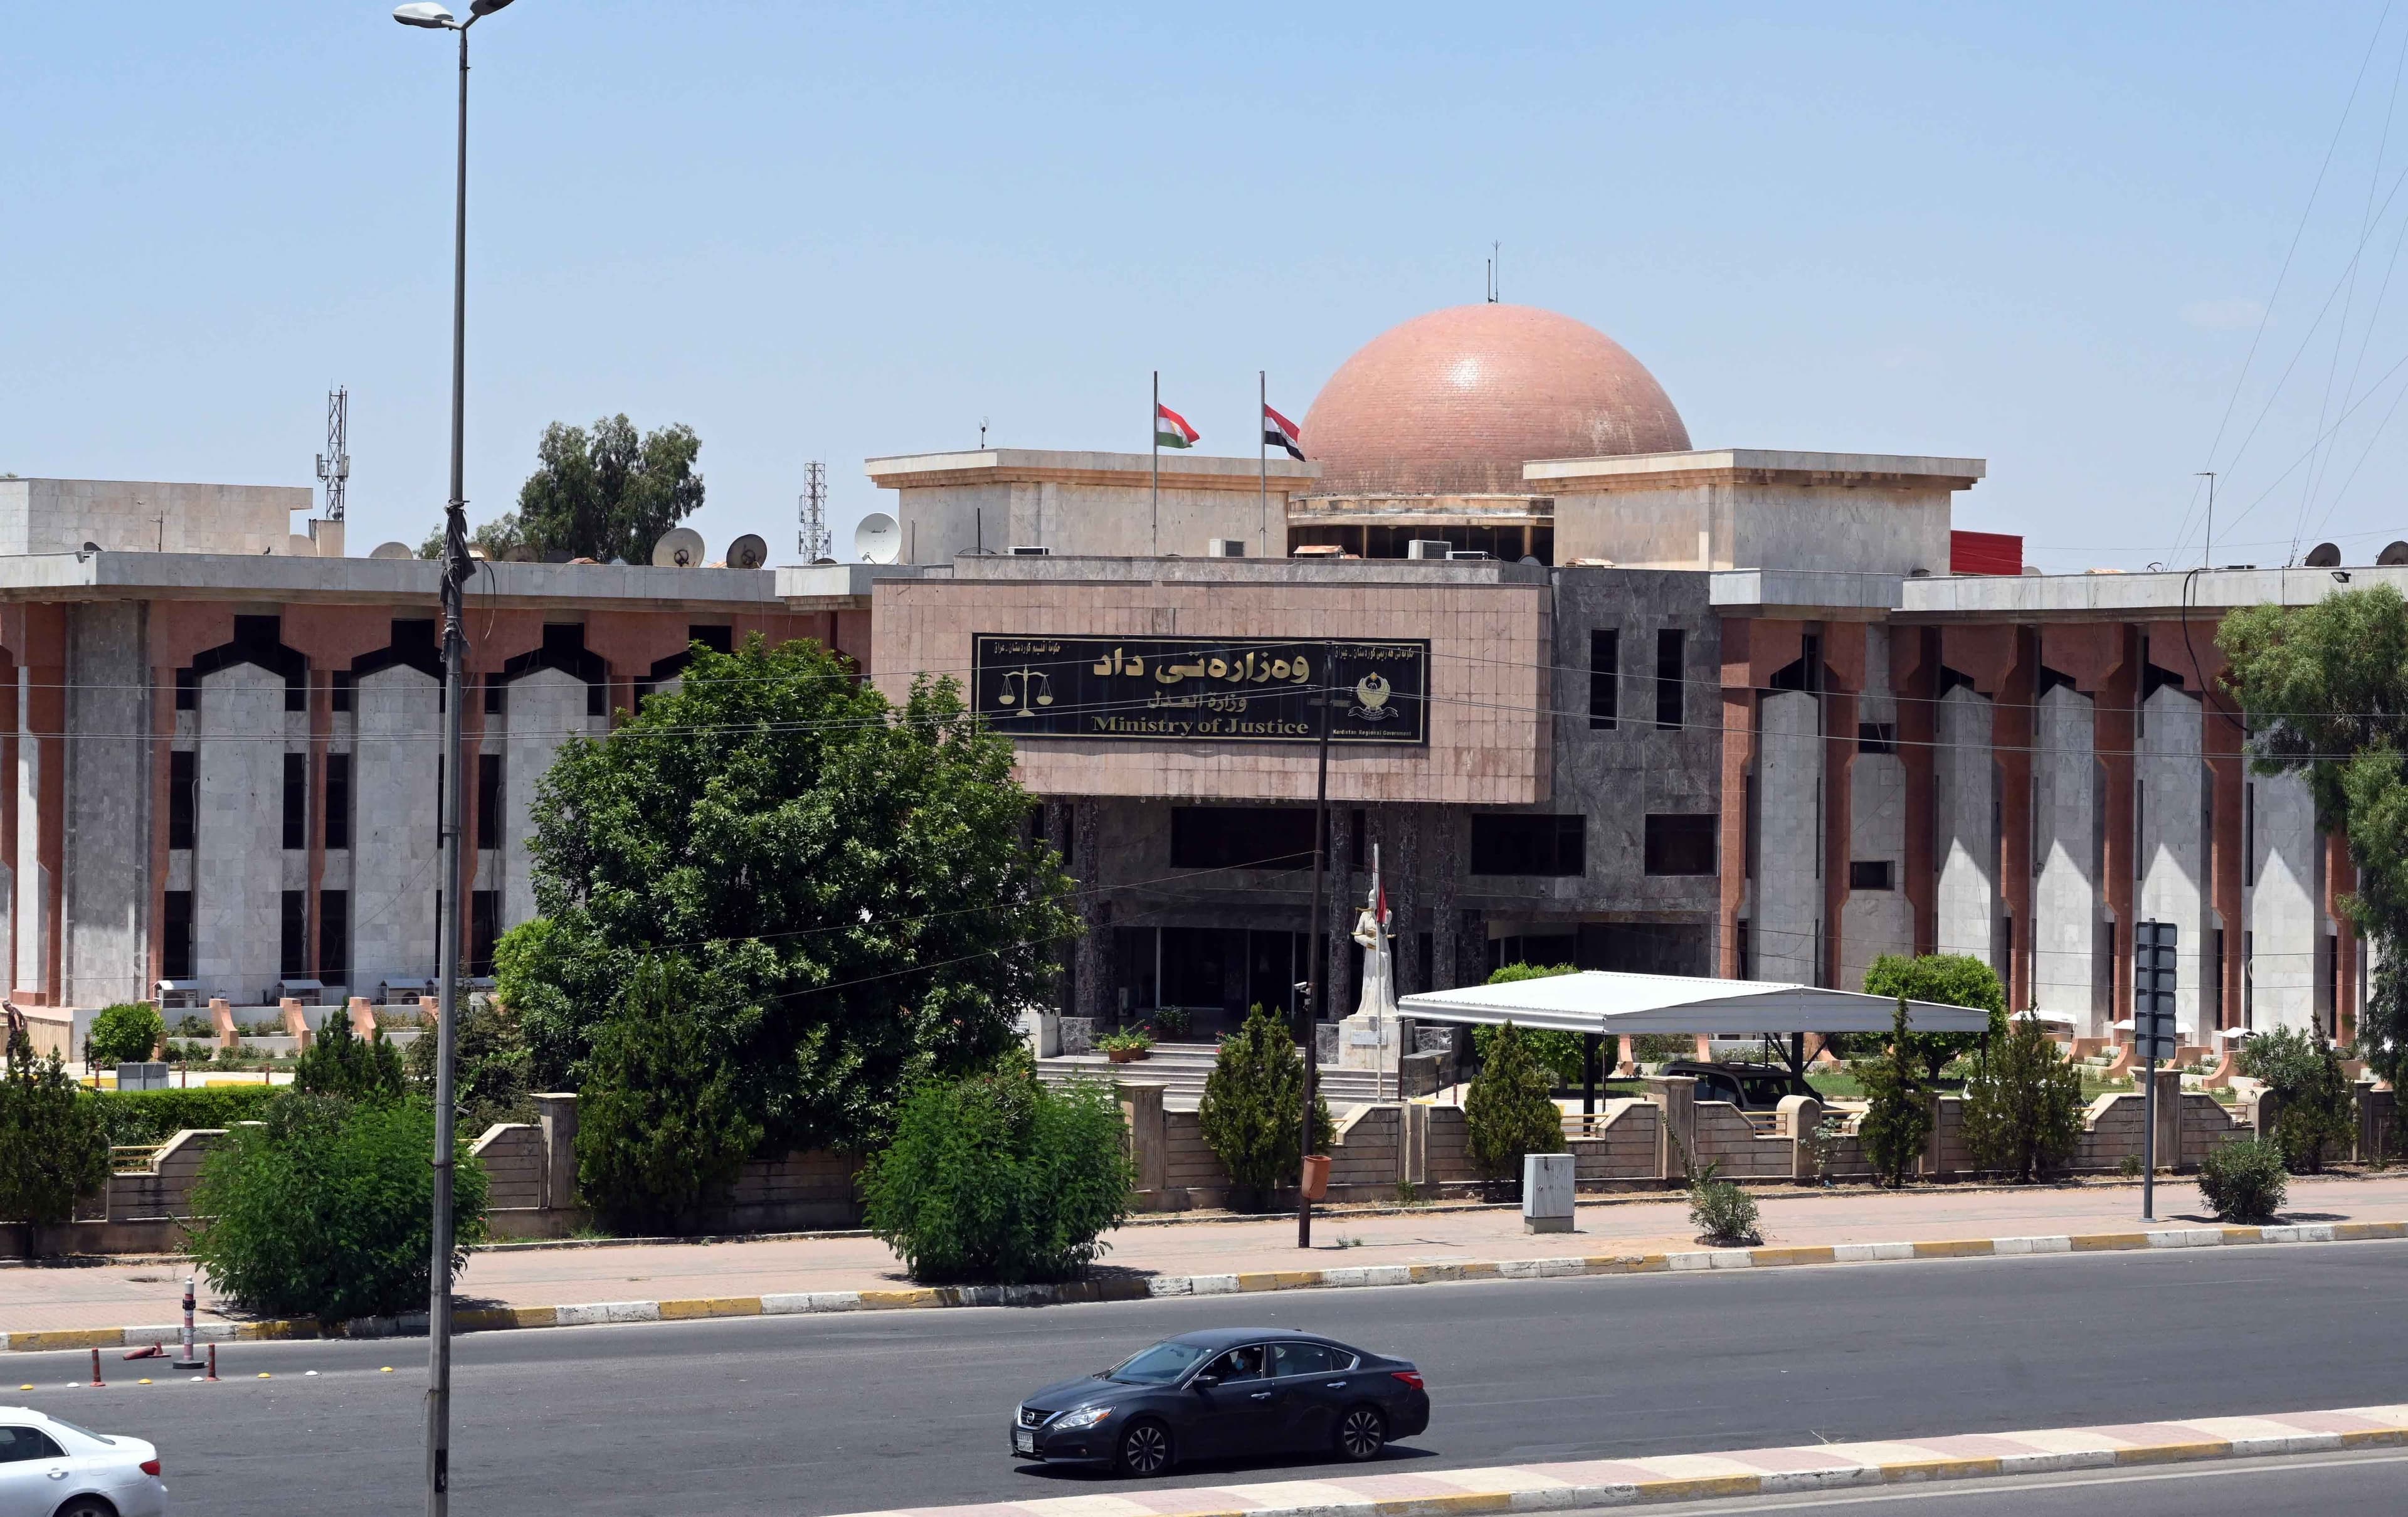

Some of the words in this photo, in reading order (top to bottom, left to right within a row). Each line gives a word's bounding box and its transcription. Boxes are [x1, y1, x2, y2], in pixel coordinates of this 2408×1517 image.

[1094, 647, 1144, 677] داد
[1148, 690, 1203, 709] العدل
[1208, 691, 1247, 712] وزارة
[1092, 716, 1194, 736] Ministry
[1198, 718, 1222, 733] of
[1225, 718, 1309, 734] Justice
